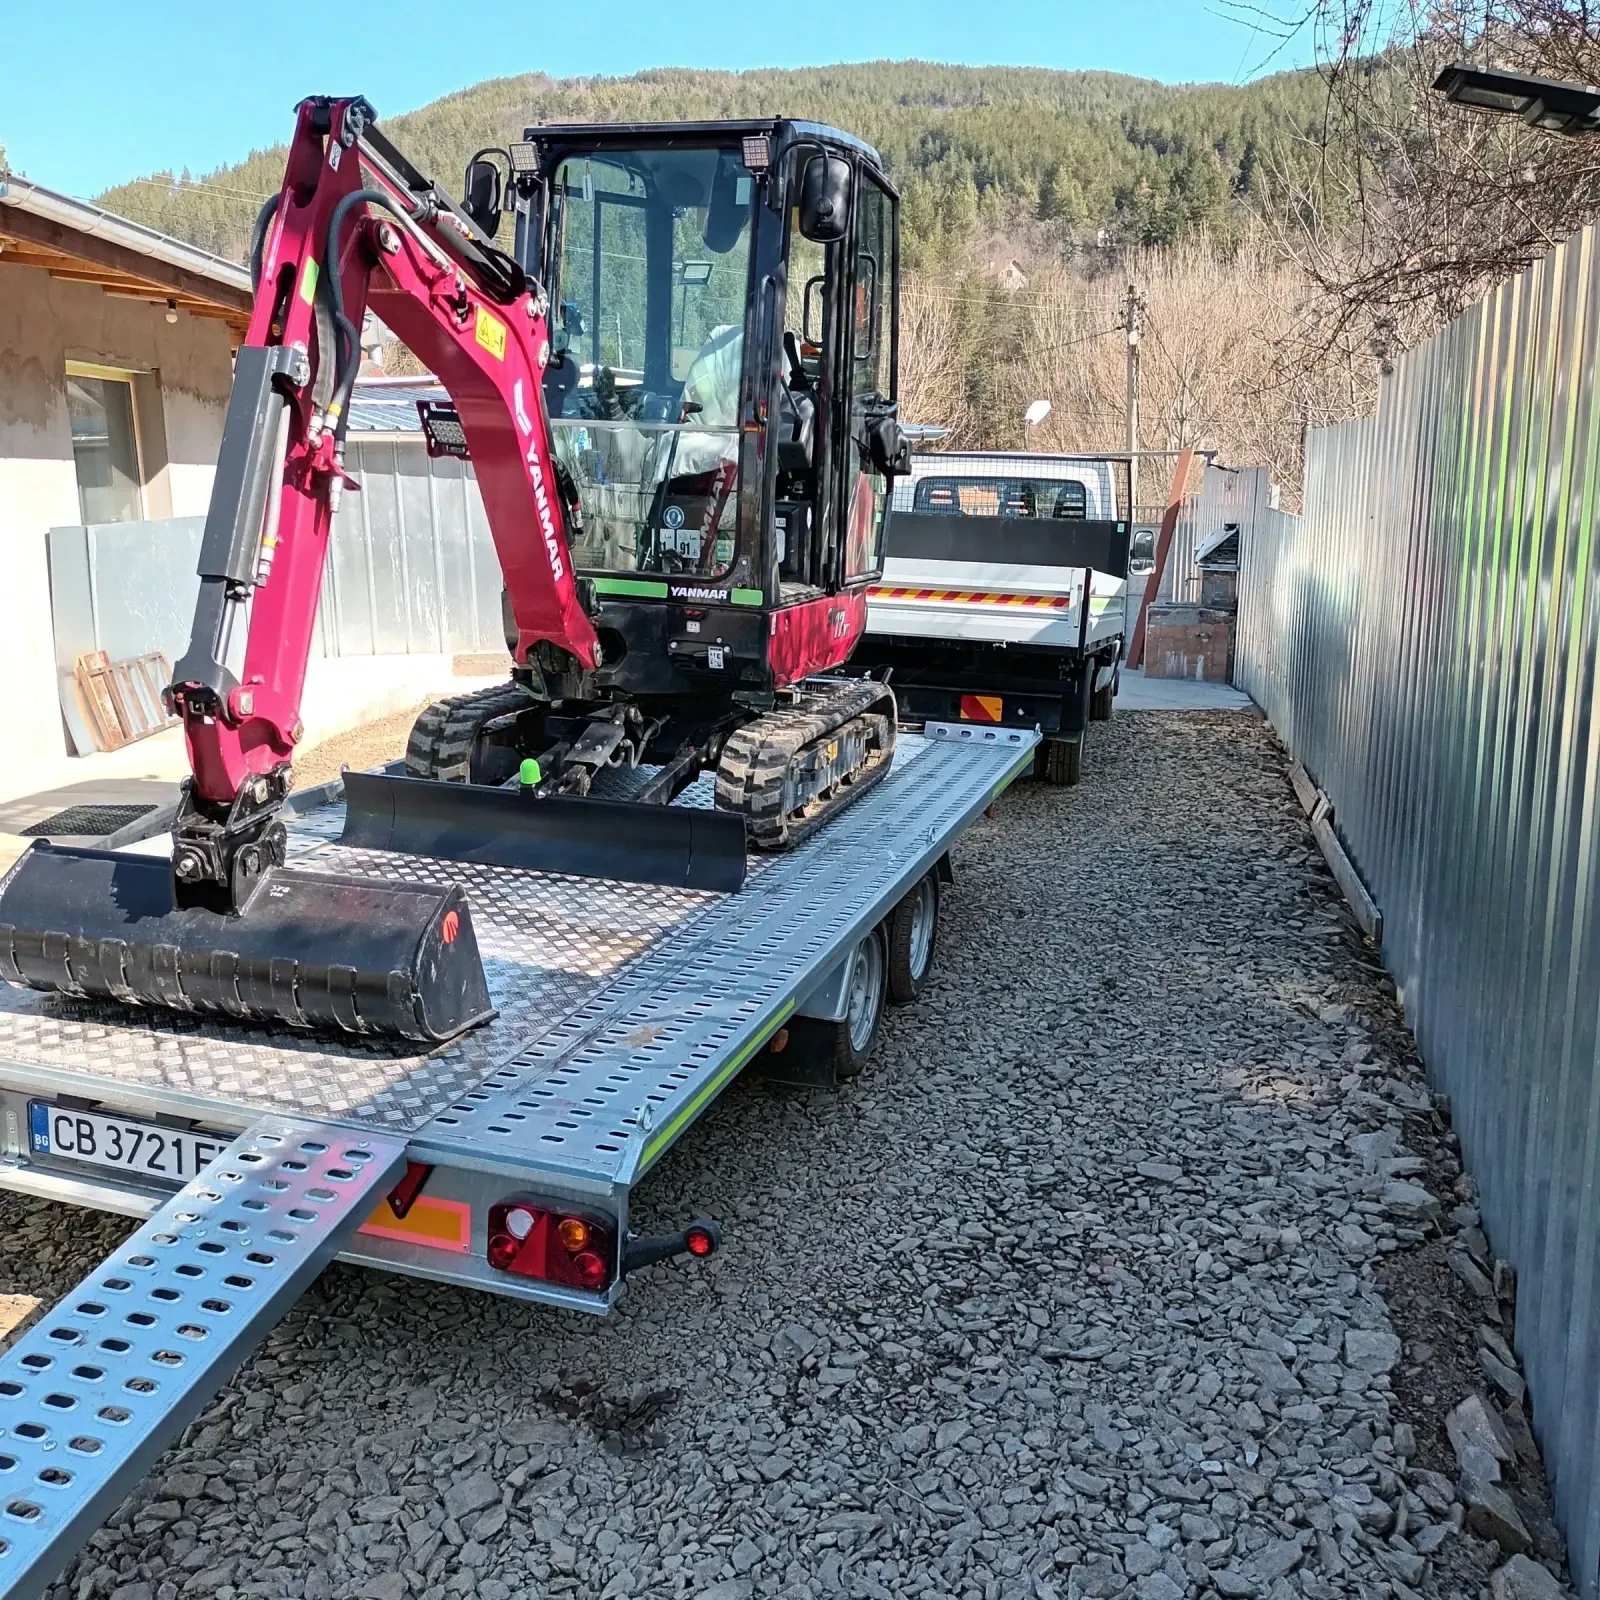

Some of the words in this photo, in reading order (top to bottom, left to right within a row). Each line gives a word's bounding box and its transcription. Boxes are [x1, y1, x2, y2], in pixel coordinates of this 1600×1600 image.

[526, 438, 564, 582] YANMAR
[680, 541, 690, 555] 91
[670, 586, 728, 600] YANMAR
[35, 1133, 49, 1147] BG
[54, 1115, 97, 1156] CB
[105, 1125, 183, 1175] 3721
